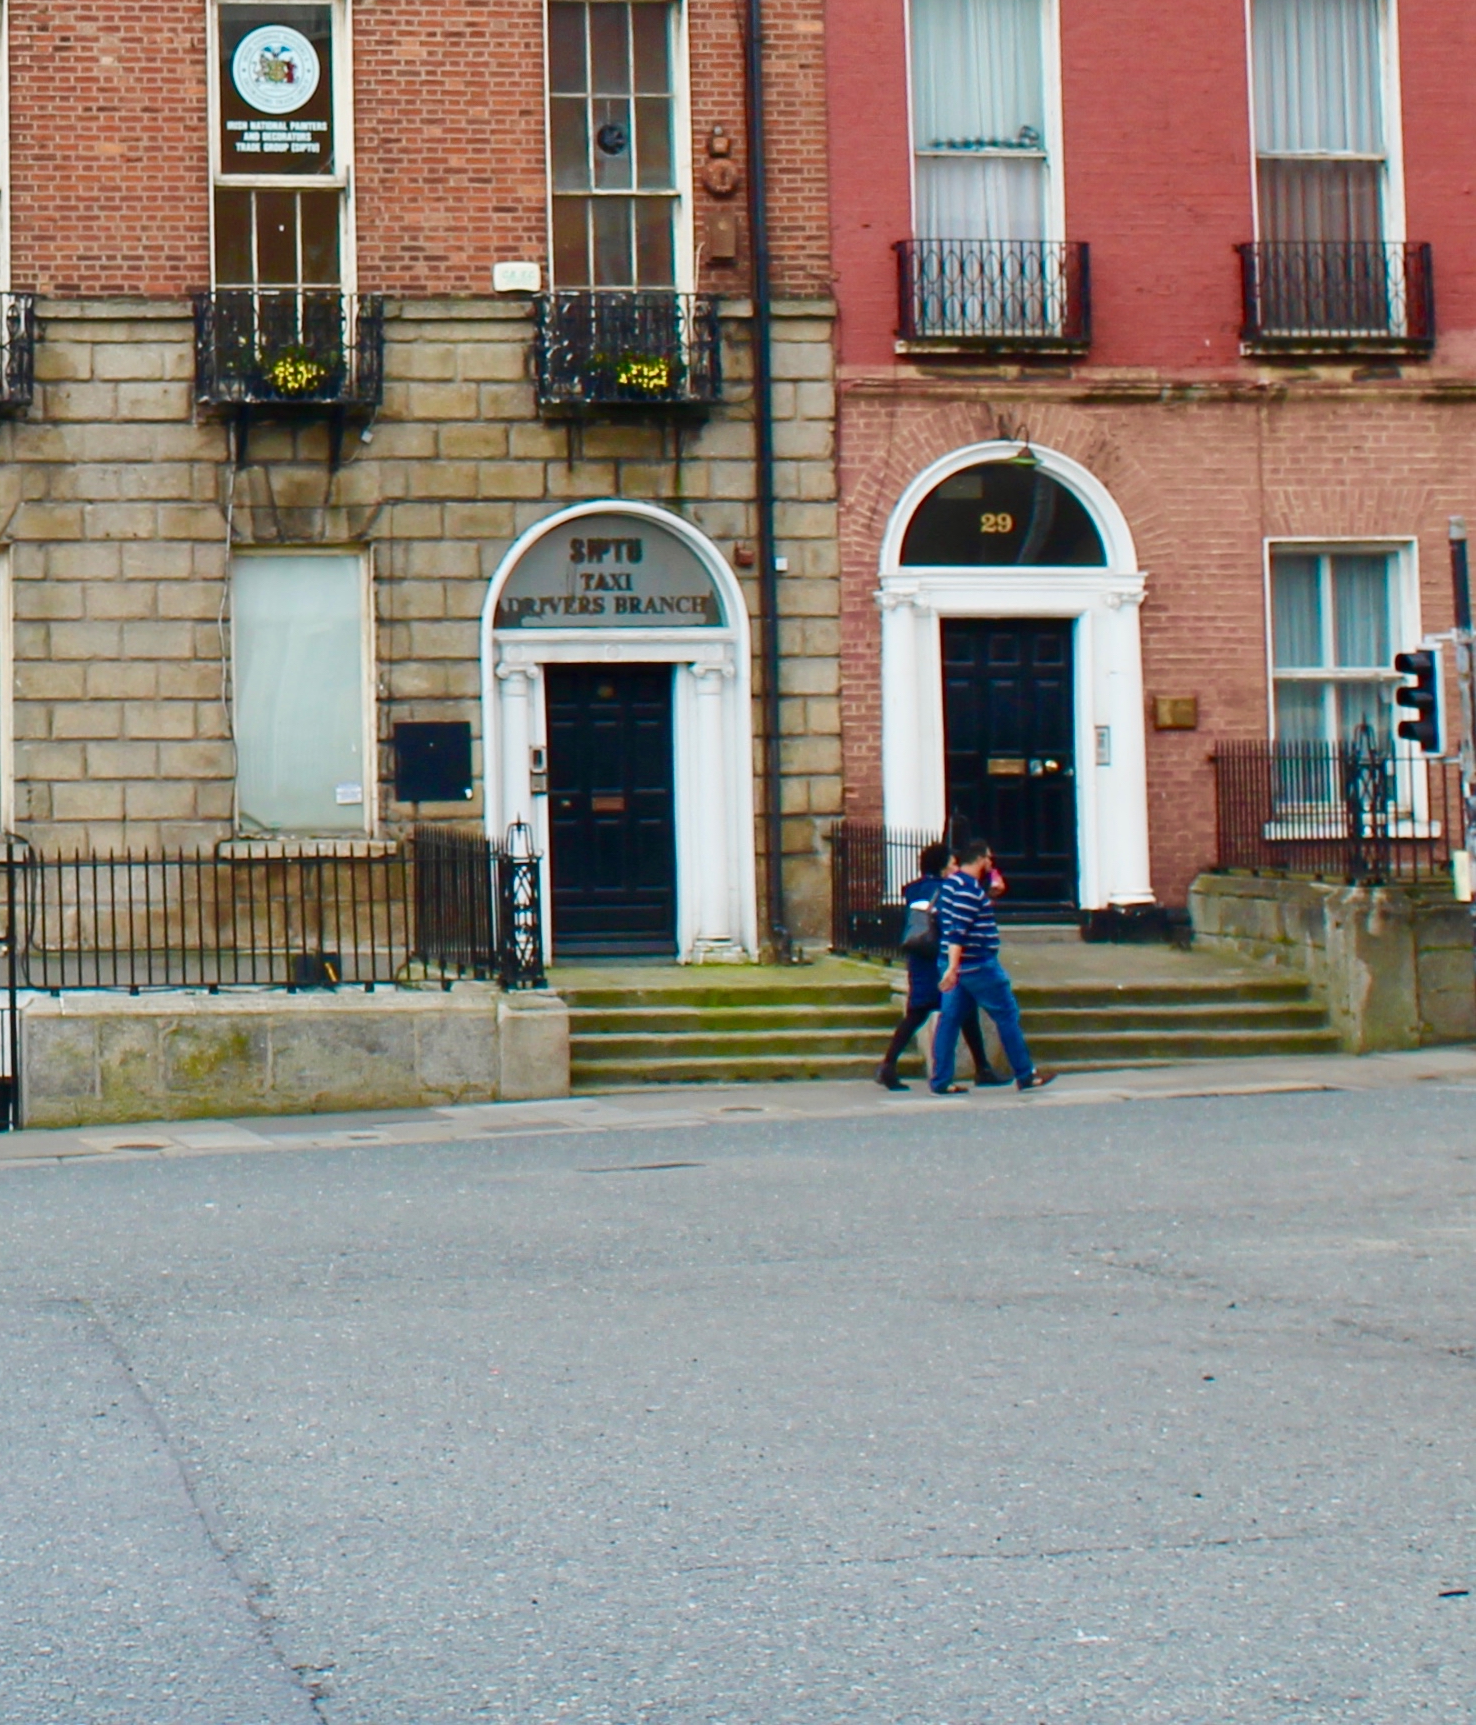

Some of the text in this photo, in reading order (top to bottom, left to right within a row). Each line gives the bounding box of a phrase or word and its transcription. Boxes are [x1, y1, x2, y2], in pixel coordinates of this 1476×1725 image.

[981, 513, 1012, 533] 29
[570, 538, 643, 564] SIPTU
[580, 573, 633, 591] TAXI
[615, 595, 706, 615] BRANCH
